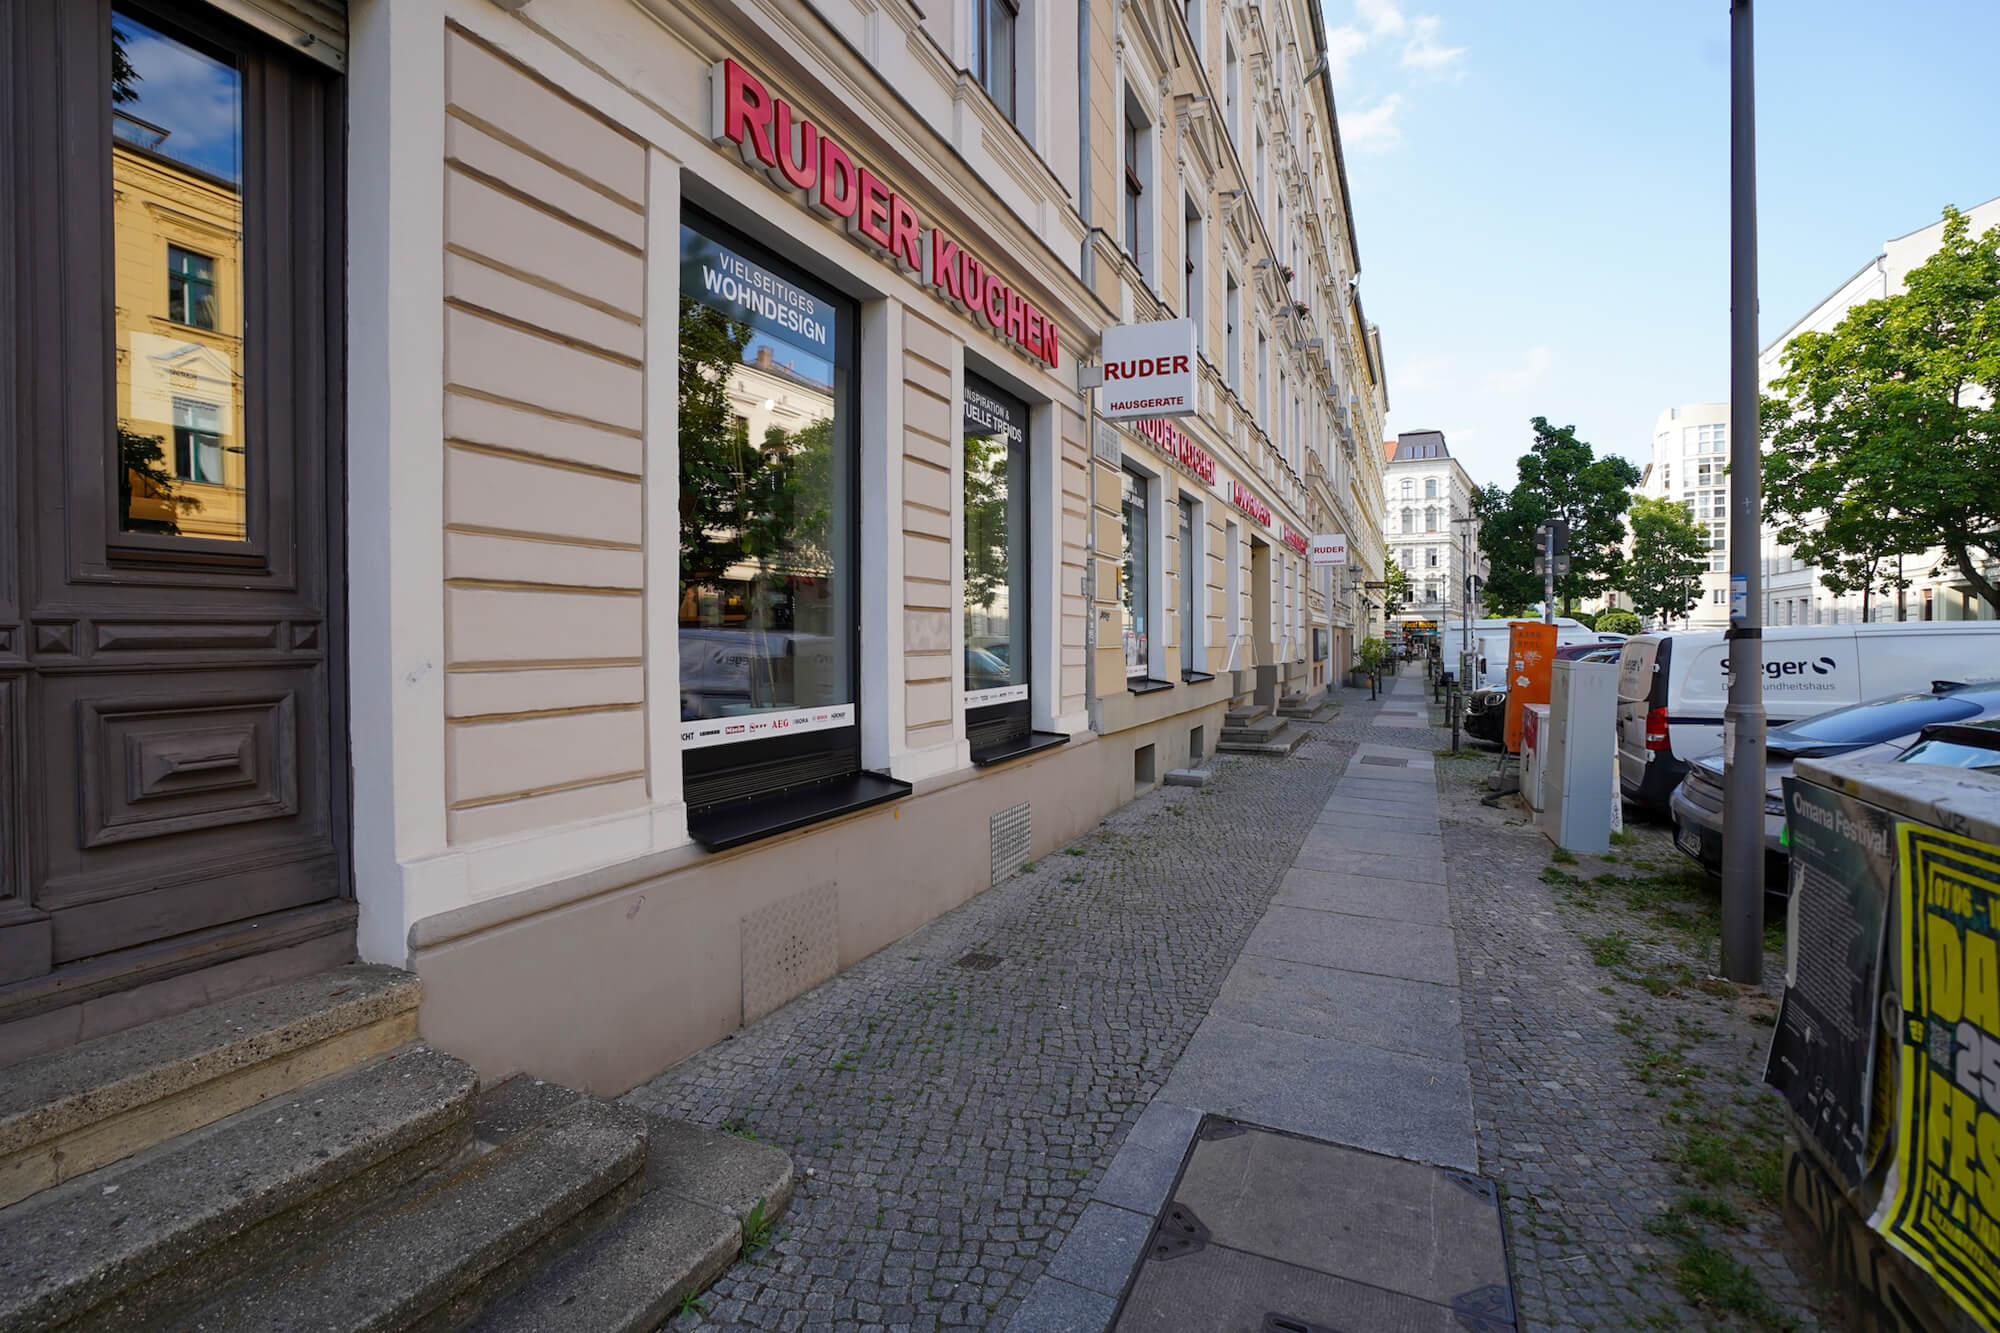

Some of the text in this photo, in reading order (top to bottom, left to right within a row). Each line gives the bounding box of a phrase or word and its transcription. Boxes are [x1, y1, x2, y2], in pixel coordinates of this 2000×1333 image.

[724, 57, 1060, 370] RUDER KÜCHEN
[719, 252, 814, 316] VIELSEITIGES
[702, 264, 827, 347] WOHNDESIGN
[1104, 355, 1190, 381] RUDER
[964, 387, 1010, 421] INSPIRATION &
[993, 417, 1023, 443] TRENDS
[1314, 545, 1345, 555] RUDER
[1720, 658, 1807, 679] Sger
[772, 719, 789, 729] AEG
[1793, 791, 1834, 831] Omana
[1836, 808, 1889, 857] Festival
